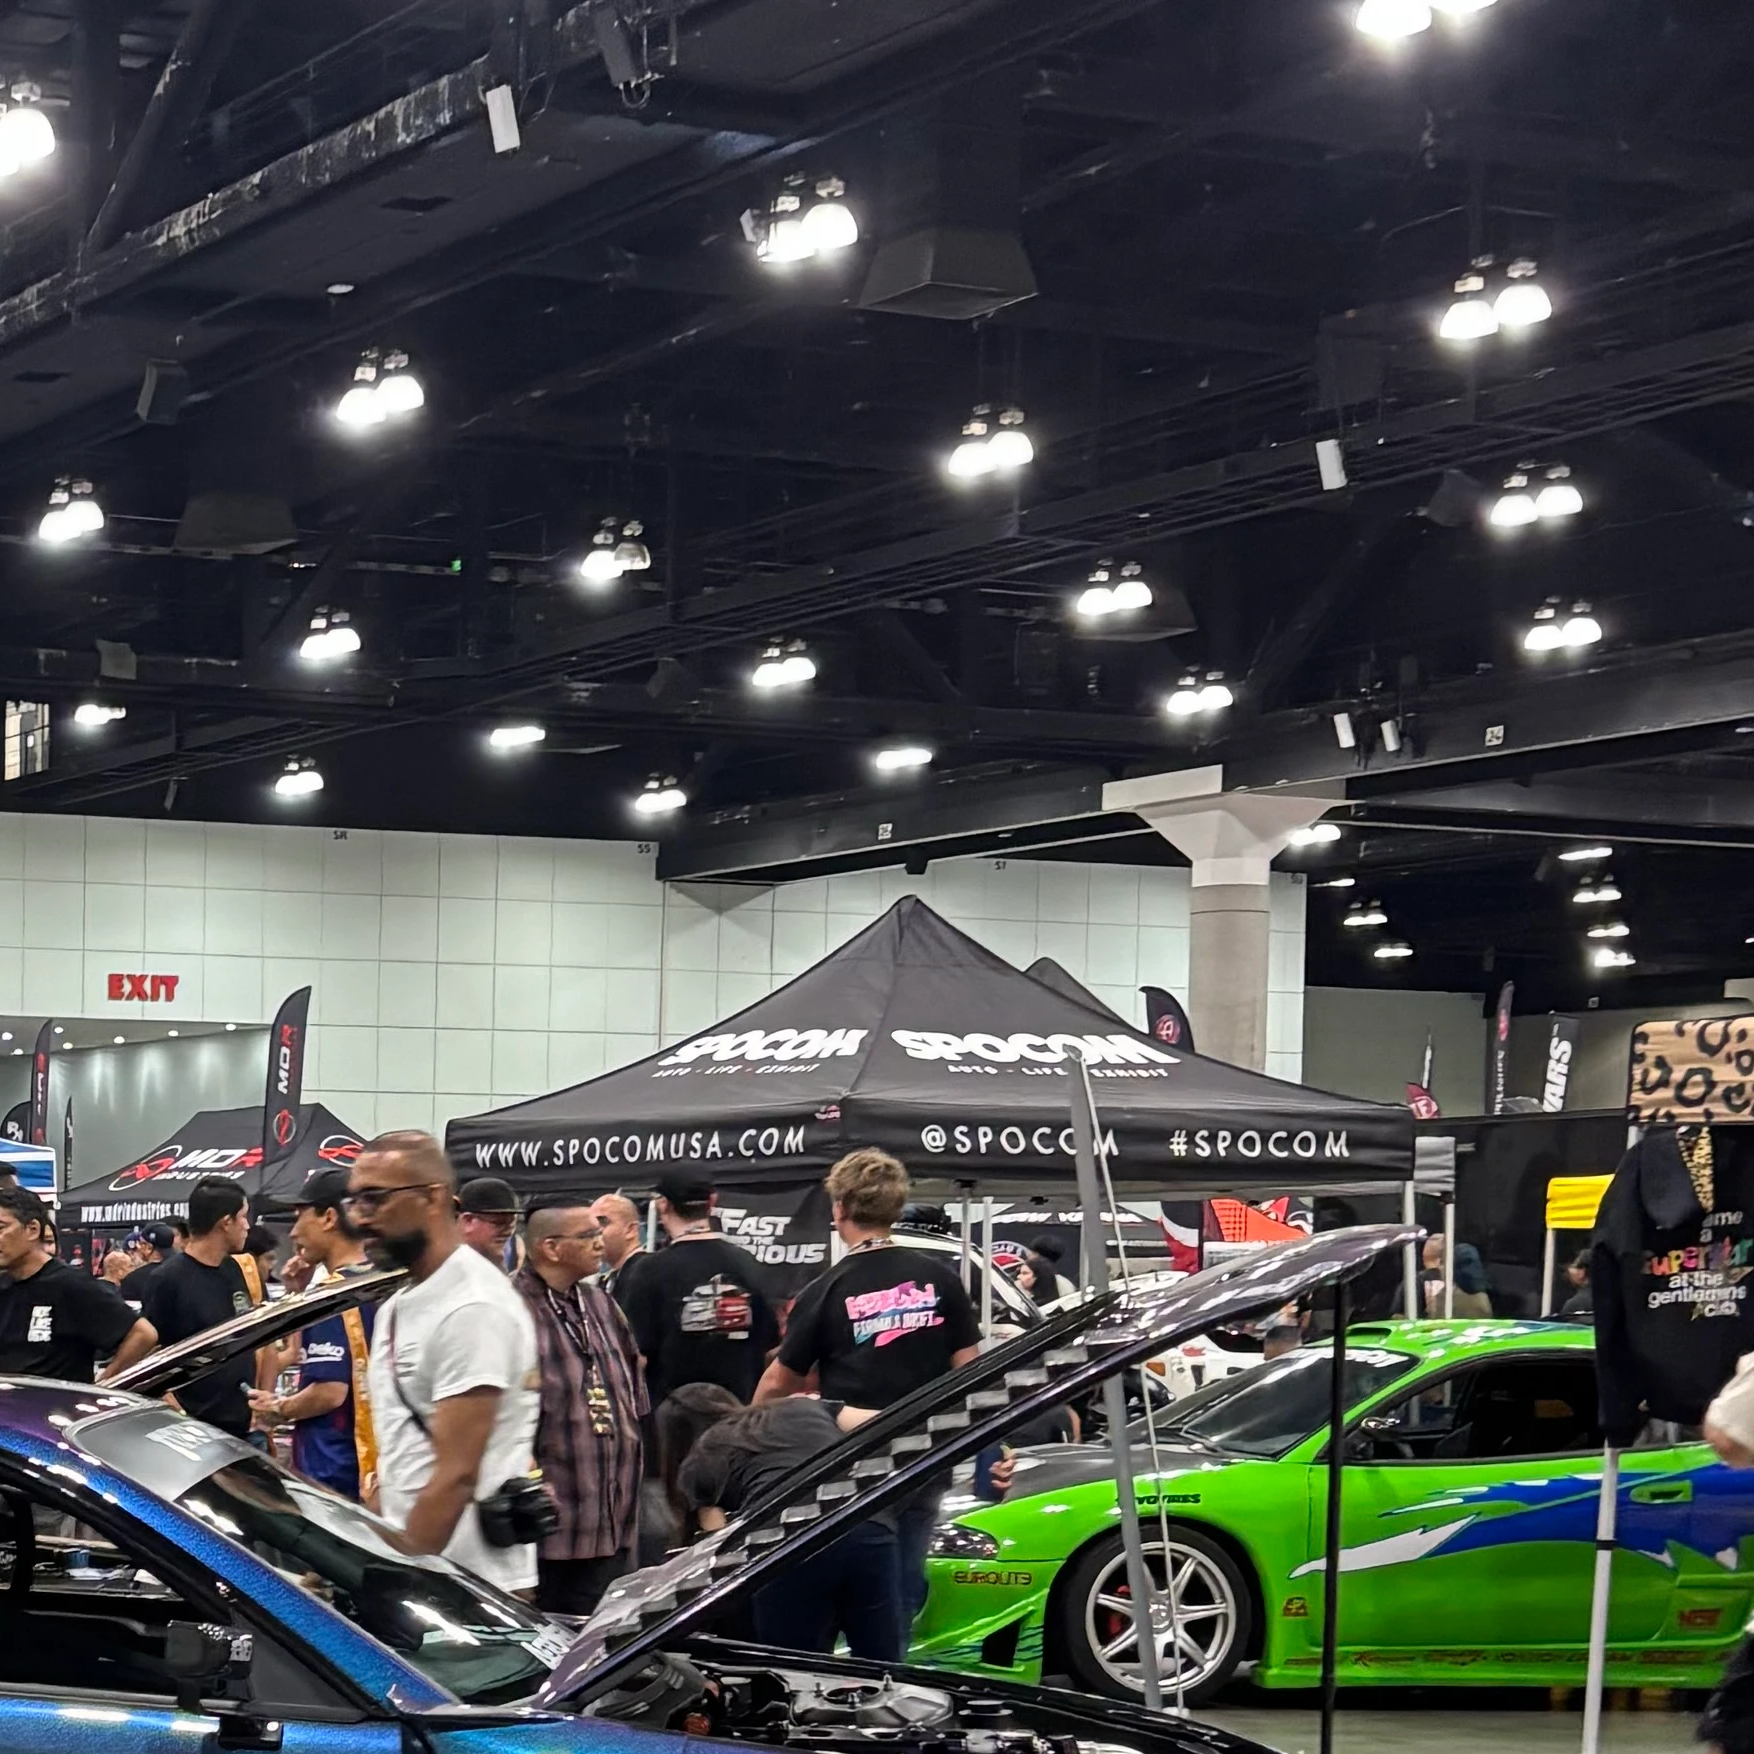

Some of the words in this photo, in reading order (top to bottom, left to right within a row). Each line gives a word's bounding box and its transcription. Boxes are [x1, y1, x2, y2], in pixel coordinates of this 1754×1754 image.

[107, 973, 178, 1002] EXIT
[657, 1029, 869, 1066] SPOCOM
[891, 1029, 1181, 1064] SPOCOM
[476, 1125, 805, 1168] WWW.SPOCOMUSA.COM
[1169, 1129, 1350, 1158] #SPOCOM
[711, 1207, 791, 1236] FAST
[747, 1242, 827, 1265] IOUS
